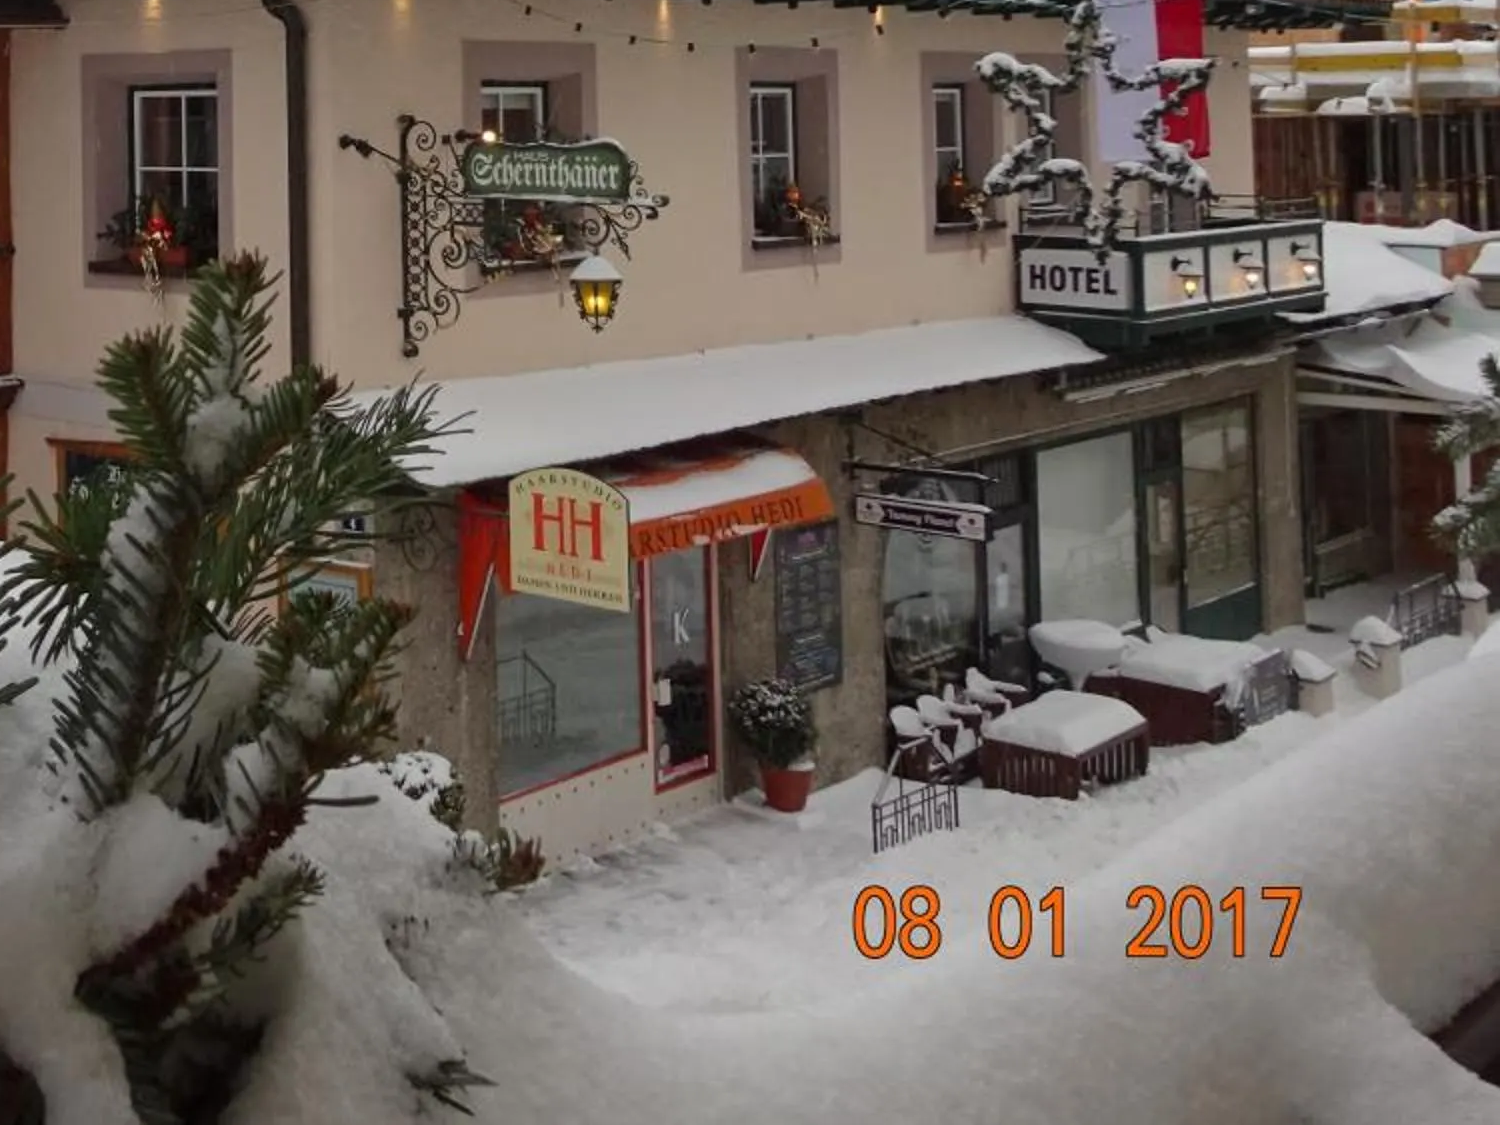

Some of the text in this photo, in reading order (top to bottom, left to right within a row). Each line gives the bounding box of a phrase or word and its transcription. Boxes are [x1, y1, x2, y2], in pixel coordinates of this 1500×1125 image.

[1028, 263, 1118, 295] HOTEL
[515, 474, 623, 511] HAARSTUDIO
[750, 495, 804, 525] HEDI
[531, 492, 605, 563] HH
